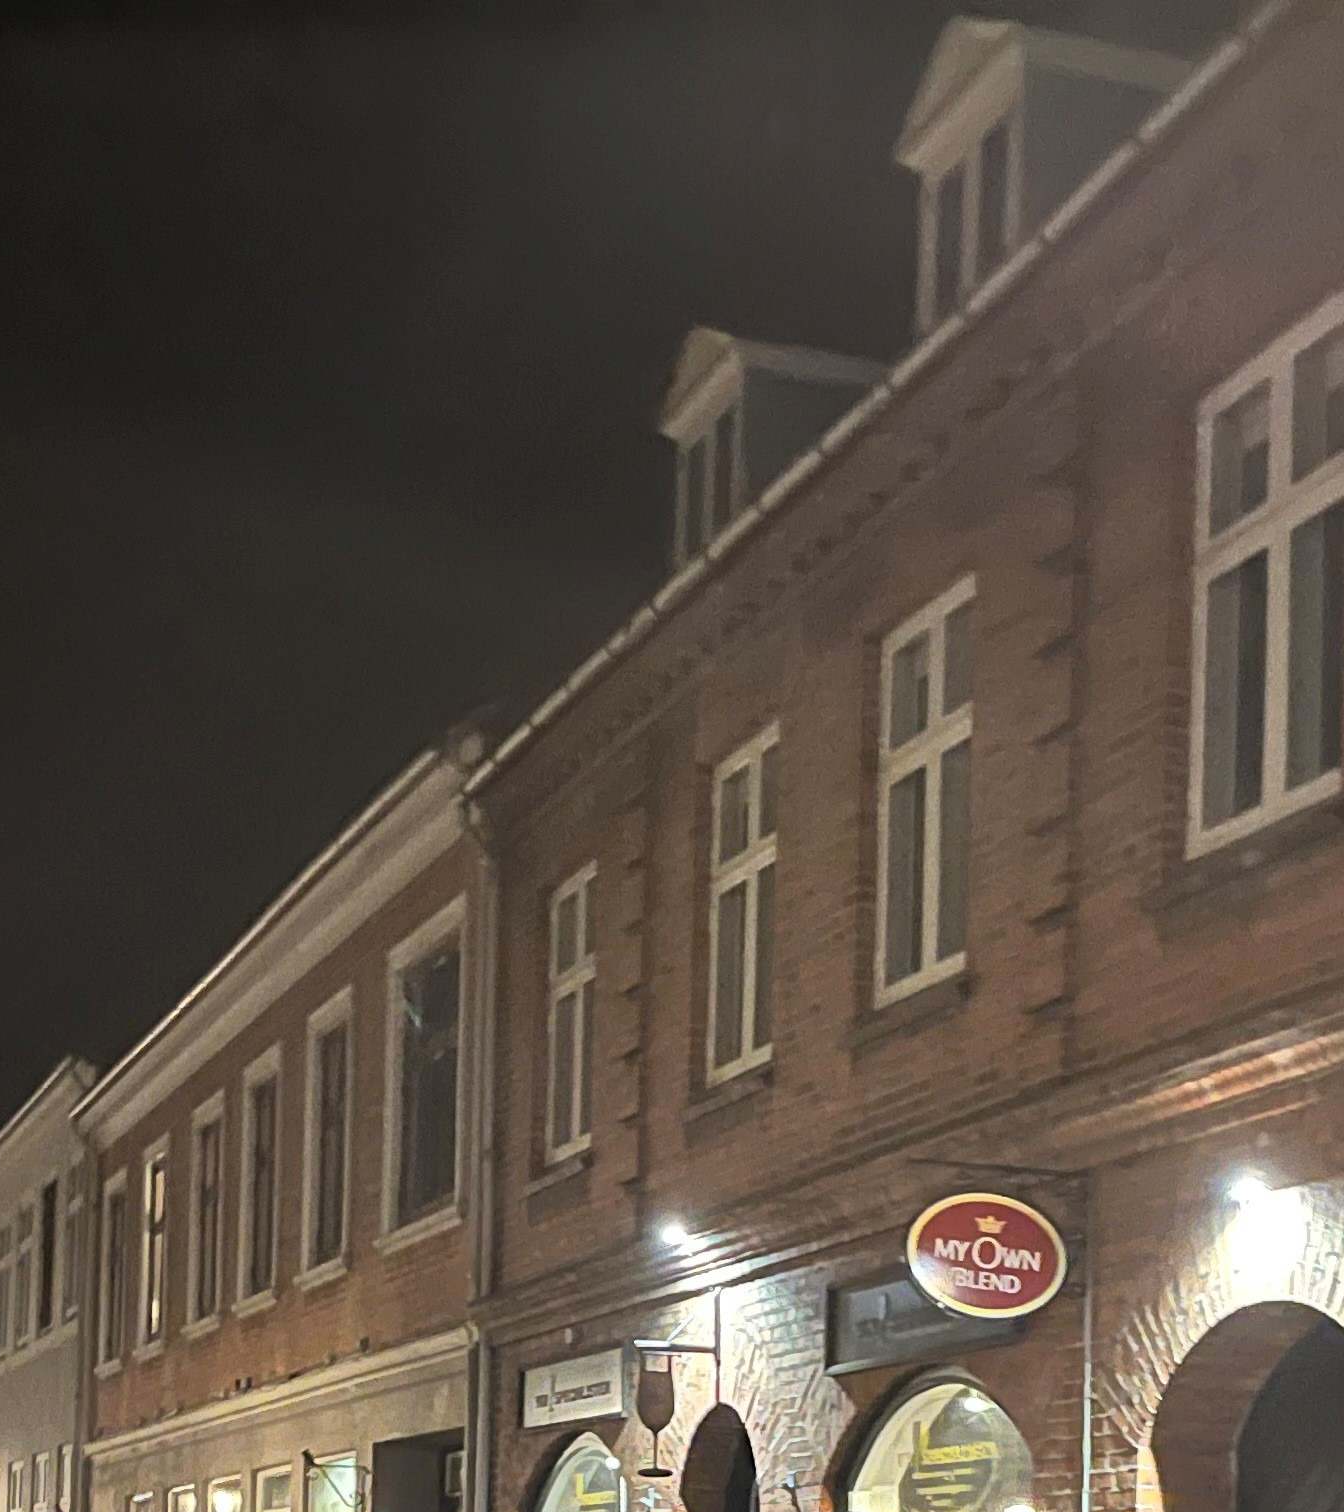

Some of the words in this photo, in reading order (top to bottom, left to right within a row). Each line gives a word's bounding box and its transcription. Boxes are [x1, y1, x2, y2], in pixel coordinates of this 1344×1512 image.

[934, 1238, 971, 1261] MY
[971, 1236, 1042, 1272] OWN
[949, 1267, 1022, 1294] BLEND
